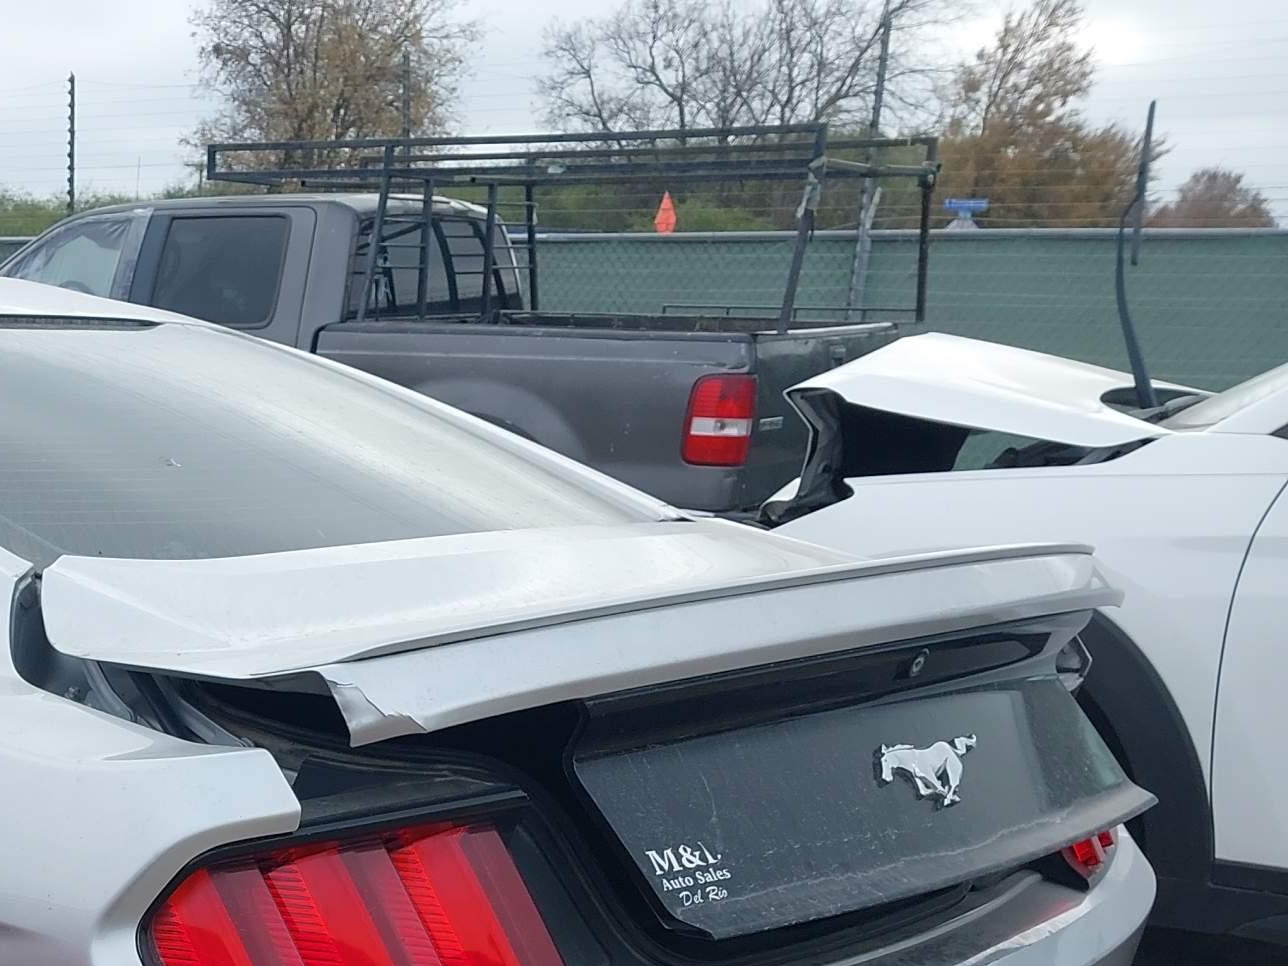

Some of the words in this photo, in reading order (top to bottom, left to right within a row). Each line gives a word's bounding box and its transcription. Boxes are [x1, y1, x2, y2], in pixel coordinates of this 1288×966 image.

[662, 876, 694, 891] Auto
[695, 867, 732, 885] Sales
[679, 889, 704, 906] Del
